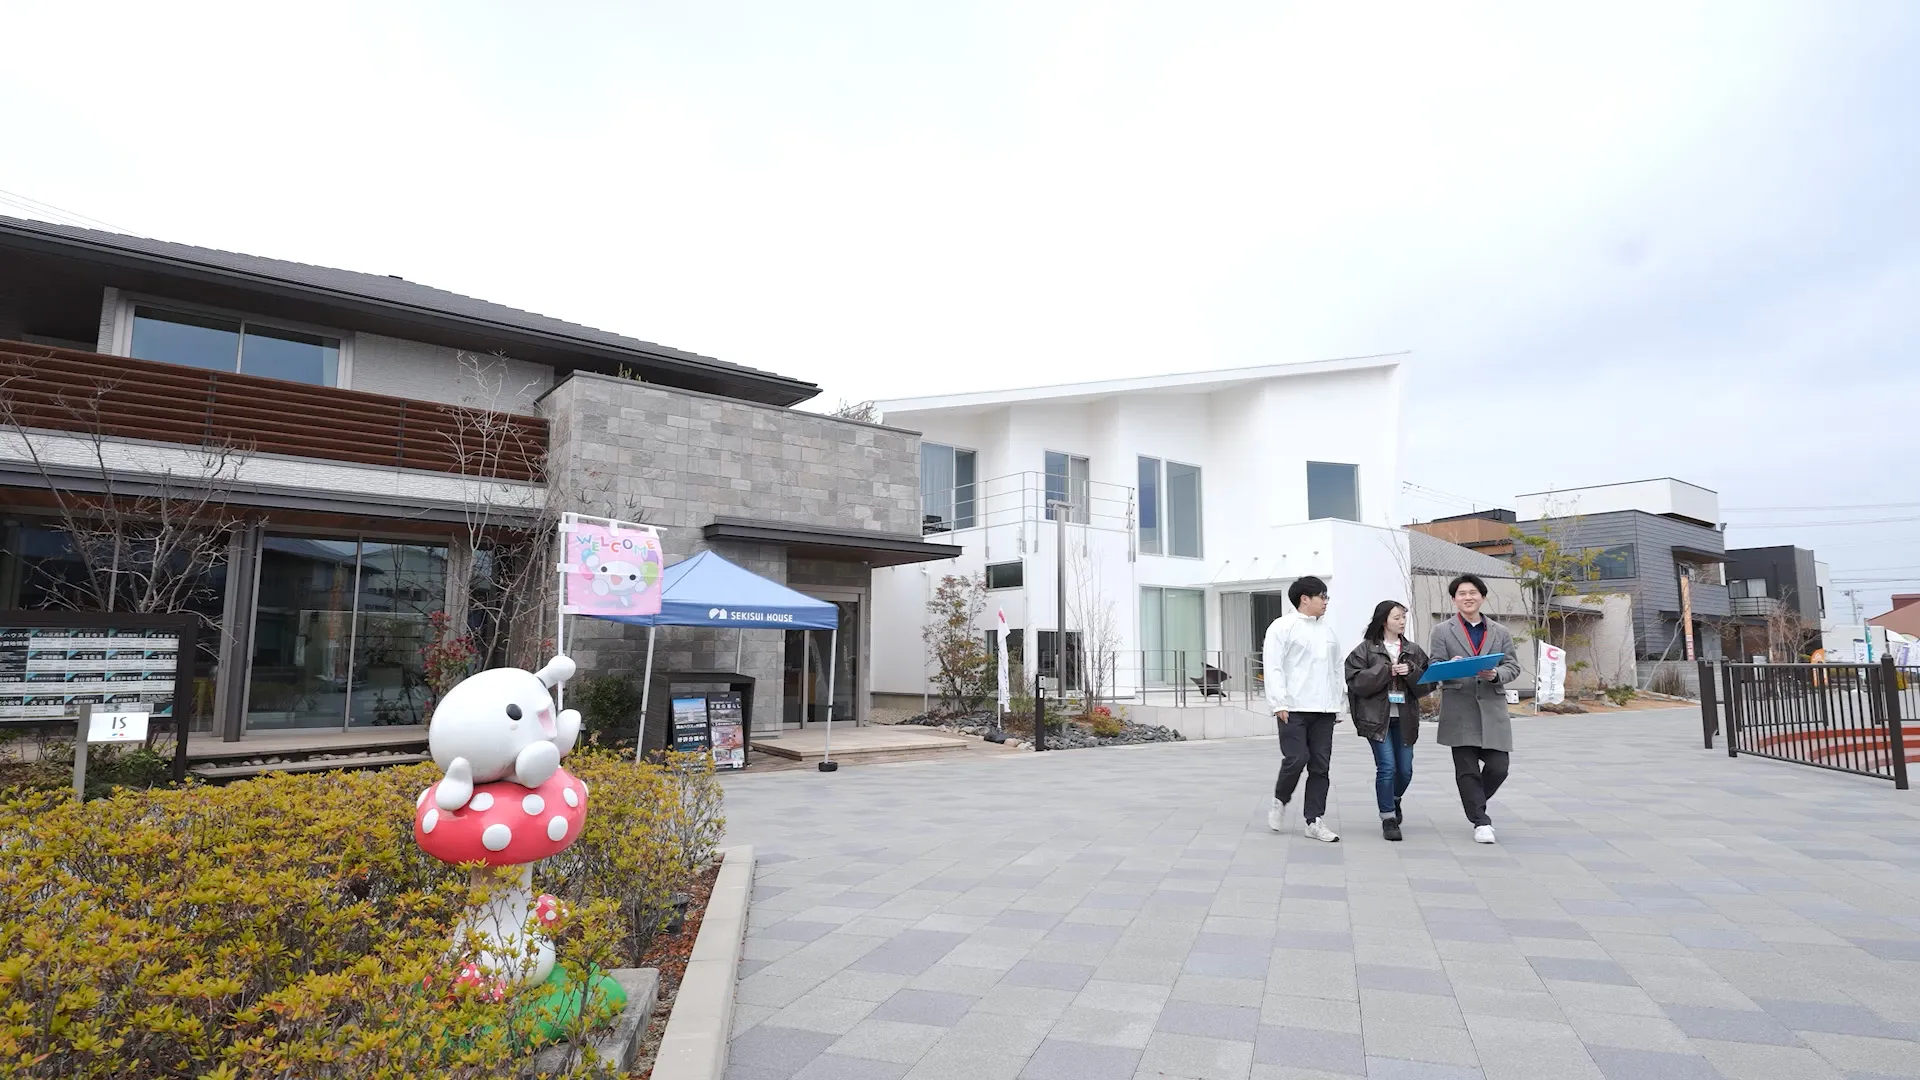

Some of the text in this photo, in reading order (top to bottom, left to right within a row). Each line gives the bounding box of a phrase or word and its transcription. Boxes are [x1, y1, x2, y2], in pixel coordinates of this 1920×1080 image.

[576, 535, 655, 557] WELCOME
[731, 611, 793, 622] SEKISUI HOUSE
